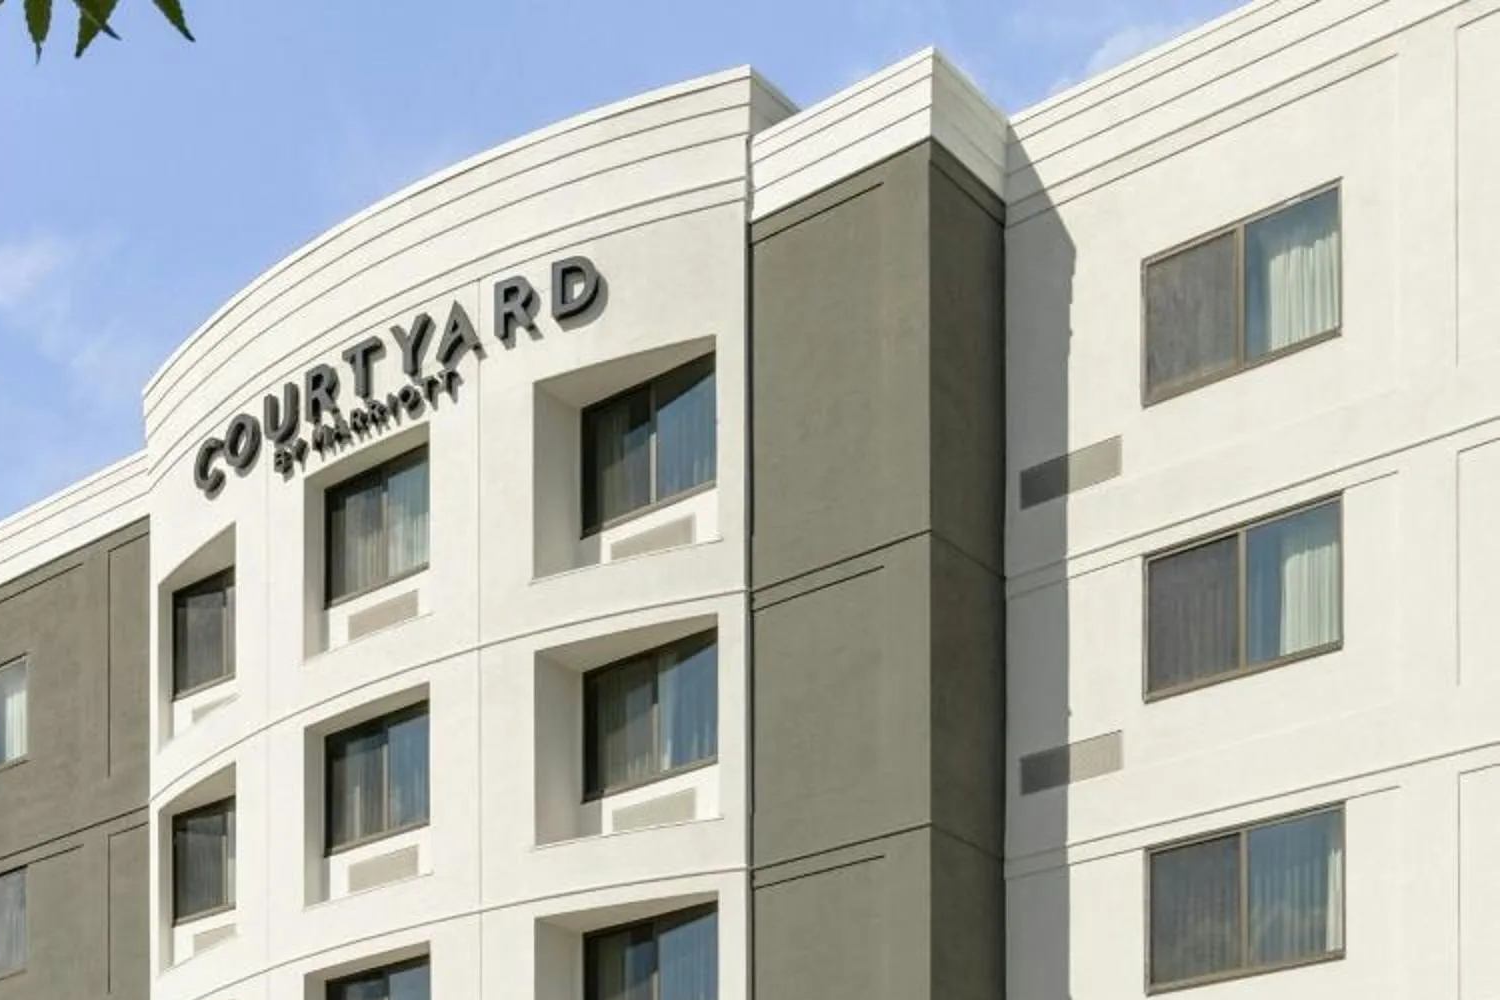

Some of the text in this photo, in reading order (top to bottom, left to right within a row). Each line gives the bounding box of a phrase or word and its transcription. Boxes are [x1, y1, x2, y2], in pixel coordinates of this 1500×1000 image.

[193, 255, 602, 495] COURTYARD
[274, 370, 463, 477] BY MARRIOTT
